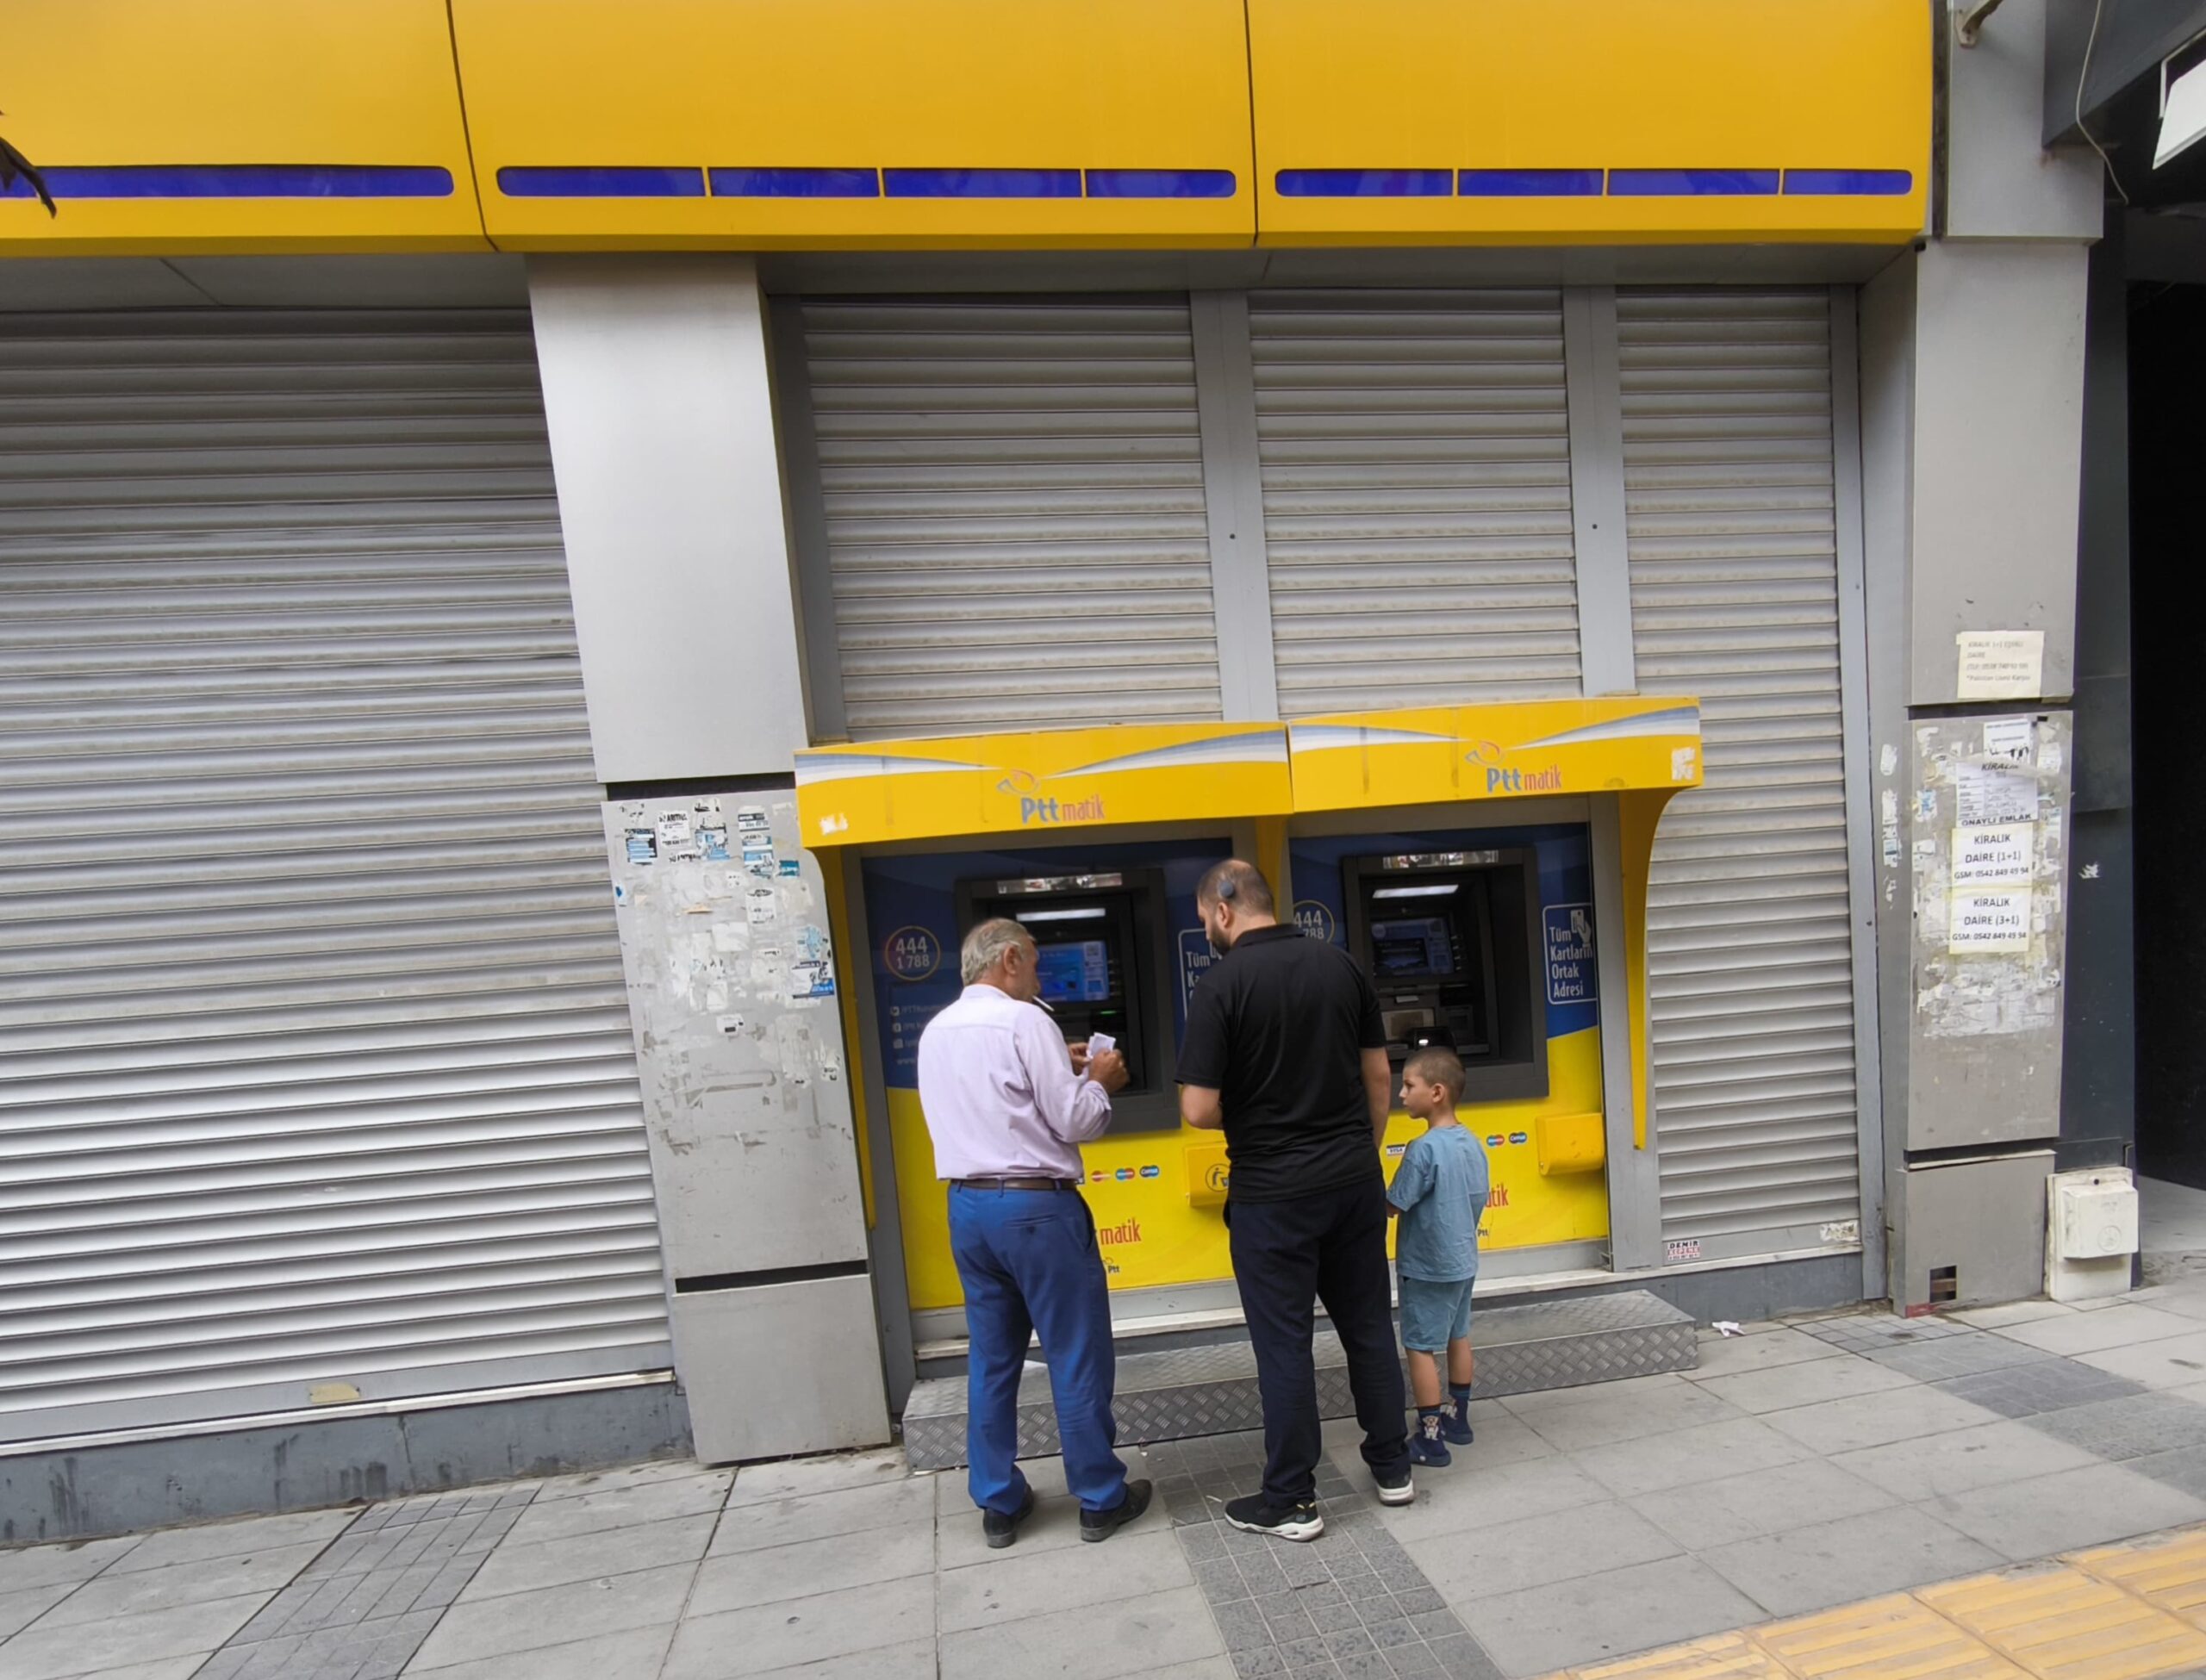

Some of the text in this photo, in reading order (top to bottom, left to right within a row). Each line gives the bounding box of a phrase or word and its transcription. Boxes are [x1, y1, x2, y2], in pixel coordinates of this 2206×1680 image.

[1961, 813, 2032, 826] ONAYLI EMLAK
[1997, 849, 2022, 863] (1+1)
[1975, 868, 1993, 878] 0542
[1293, 910, 1323, 928] 444
[1996, 914, 2020, 926] (3+1)
[1549, 926, 1572, 943] Tüm
[896, 936, 928, 955] 444
[1550, 944, 1593, 962] Kartların
[1186, 950, 1211, 968] Tüm
[1552, 962, 1580, 980] Ortak
[1554, 980, 1584, 999] Adresi
[1100, 1217, 1142, 1246] matik
